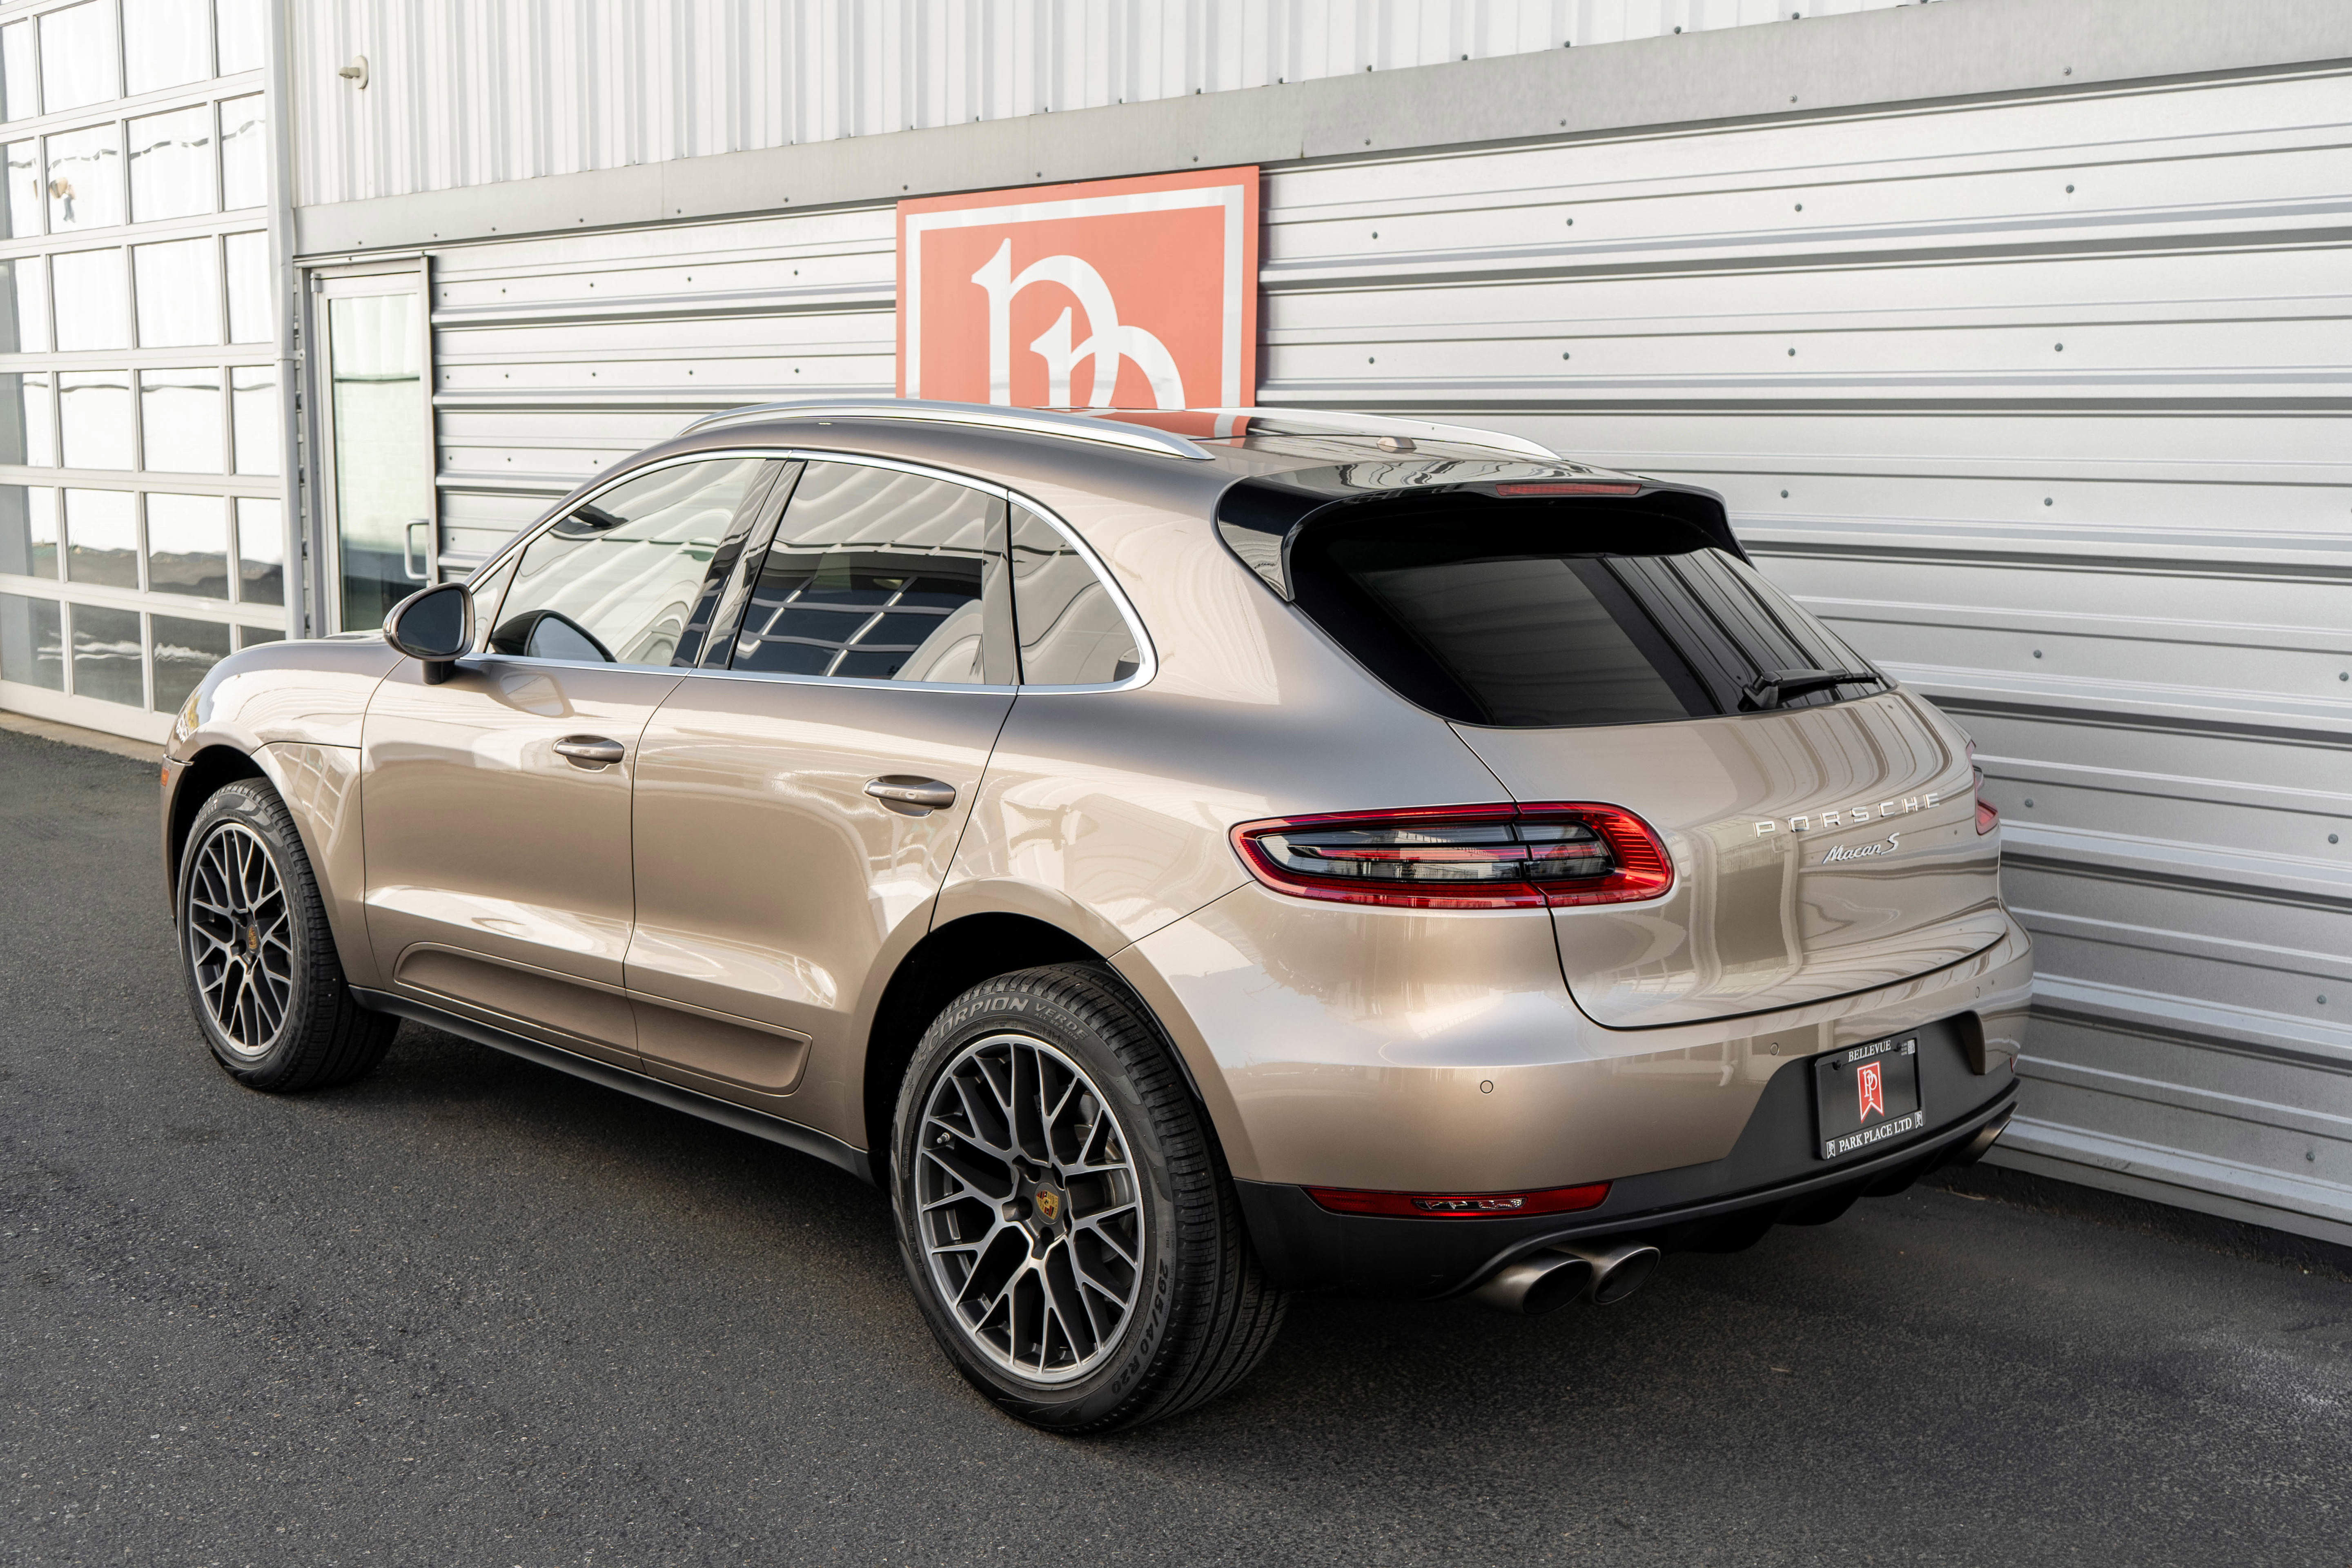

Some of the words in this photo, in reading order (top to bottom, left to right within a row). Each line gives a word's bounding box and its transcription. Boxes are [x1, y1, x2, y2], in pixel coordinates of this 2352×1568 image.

[1753, 793, 1940, 838] PORSCHE
[1822, 844, 1881, 864] Macan
[1881, 832, 1900, 855] S
[918, 997, 1029, 1069] SCORPION
[1035, 1003, 1089, 1040] VERDE
[1049, 1019, 1078, 1040] SEASON
[1849, 1040, 1891, 1062] BELLEVUE
[1839, 1137, 1862, 1152] PARK
[1864, 1124, 1893, 1143] PLACE
[1894, 1118, 1912, 1133] LTD
[1140, 1259, 1168, 1355] 295/40
[1111, 1355, 1141, 1394] R20
